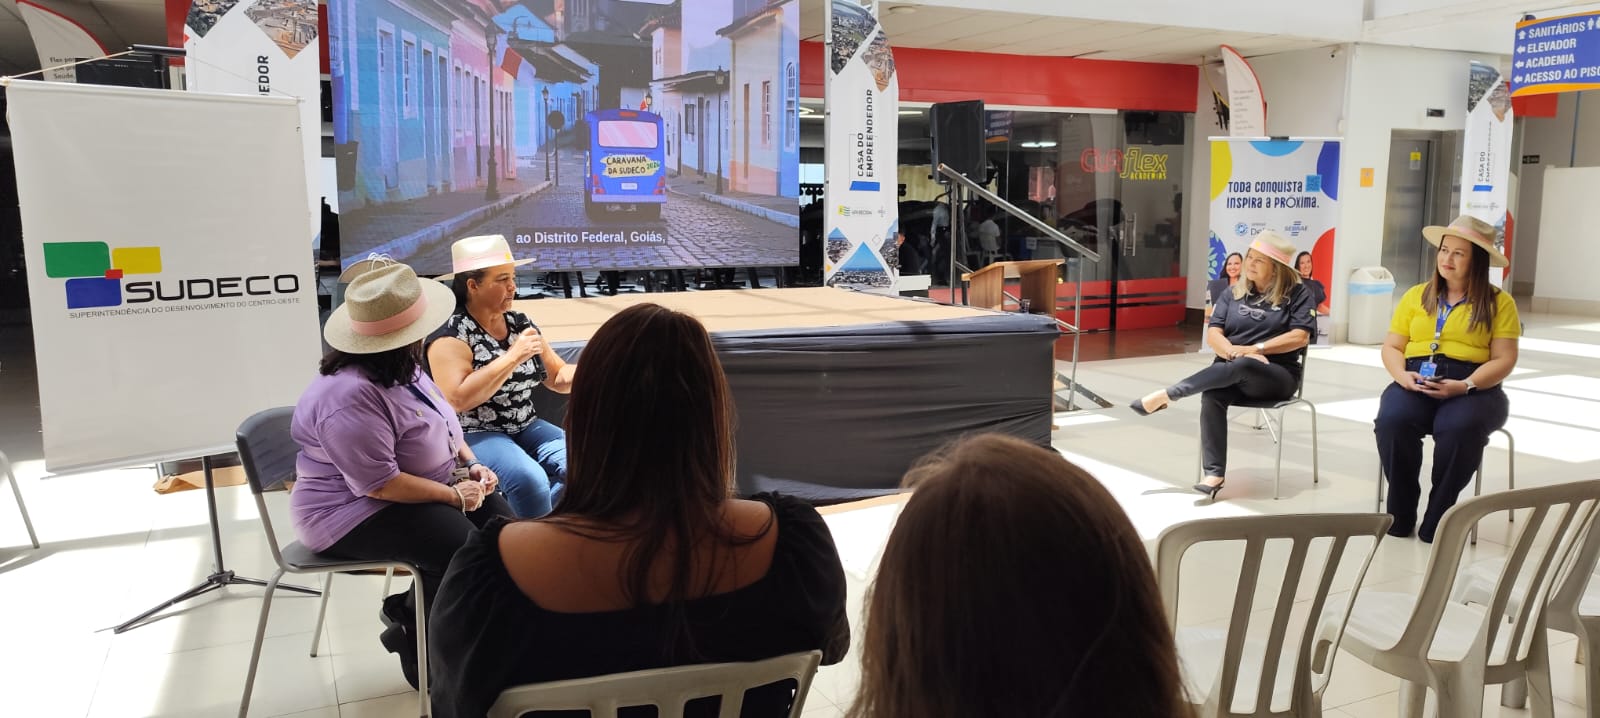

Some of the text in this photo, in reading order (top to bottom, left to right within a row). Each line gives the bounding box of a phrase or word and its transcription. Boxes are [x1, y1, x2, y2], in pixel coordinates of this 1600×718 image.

[1528, 21, 1586, 39] SANITÁRIOS
[1527, 38, 1577, 53] ELEVADOR
[1525, 53, 1575, 68] ACADEMIA
[1524, 70, 1562, 83] ACESSO
[1563, 68, 1578, 80] AO
[857, 132, 864, 147] DO
[606, 155, 647, 165] CARAVANA
[619, 166, 646, 174] SUDECO
[515, 231, 666, 245] ao Distrito Federal, Goiás,
[125, 274, 299, 304] SUDECO
[69, 307, 151, 319] SUPERINTENDÊNCIA
[151, 306, 163, 314] DO
[164, 301, 235, 313] DESENVOLVIMENTO
